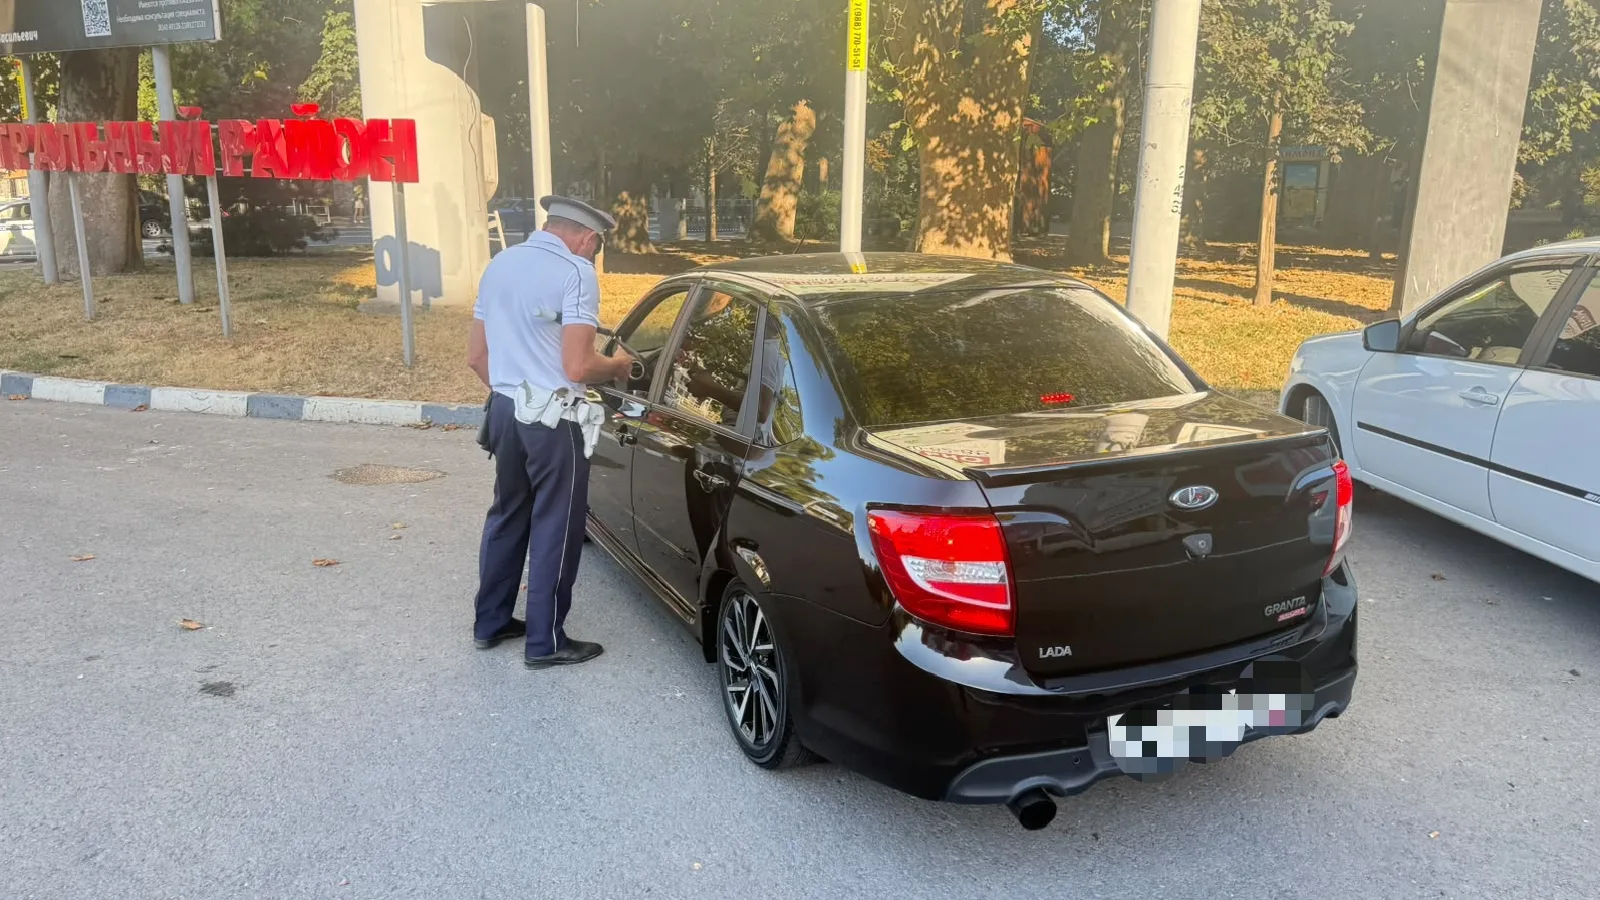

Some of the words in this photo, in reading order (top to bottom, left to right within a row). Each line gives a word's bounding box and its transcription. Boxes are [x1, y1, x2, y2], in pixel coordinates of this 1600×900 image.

[853, 32, 862, 68] 770-51-51
[217, 103, 419, 183] РАЙОН
[1264, 595, 1306, 616] GRANTA
[1038, 645, 1073, 659] LADA
